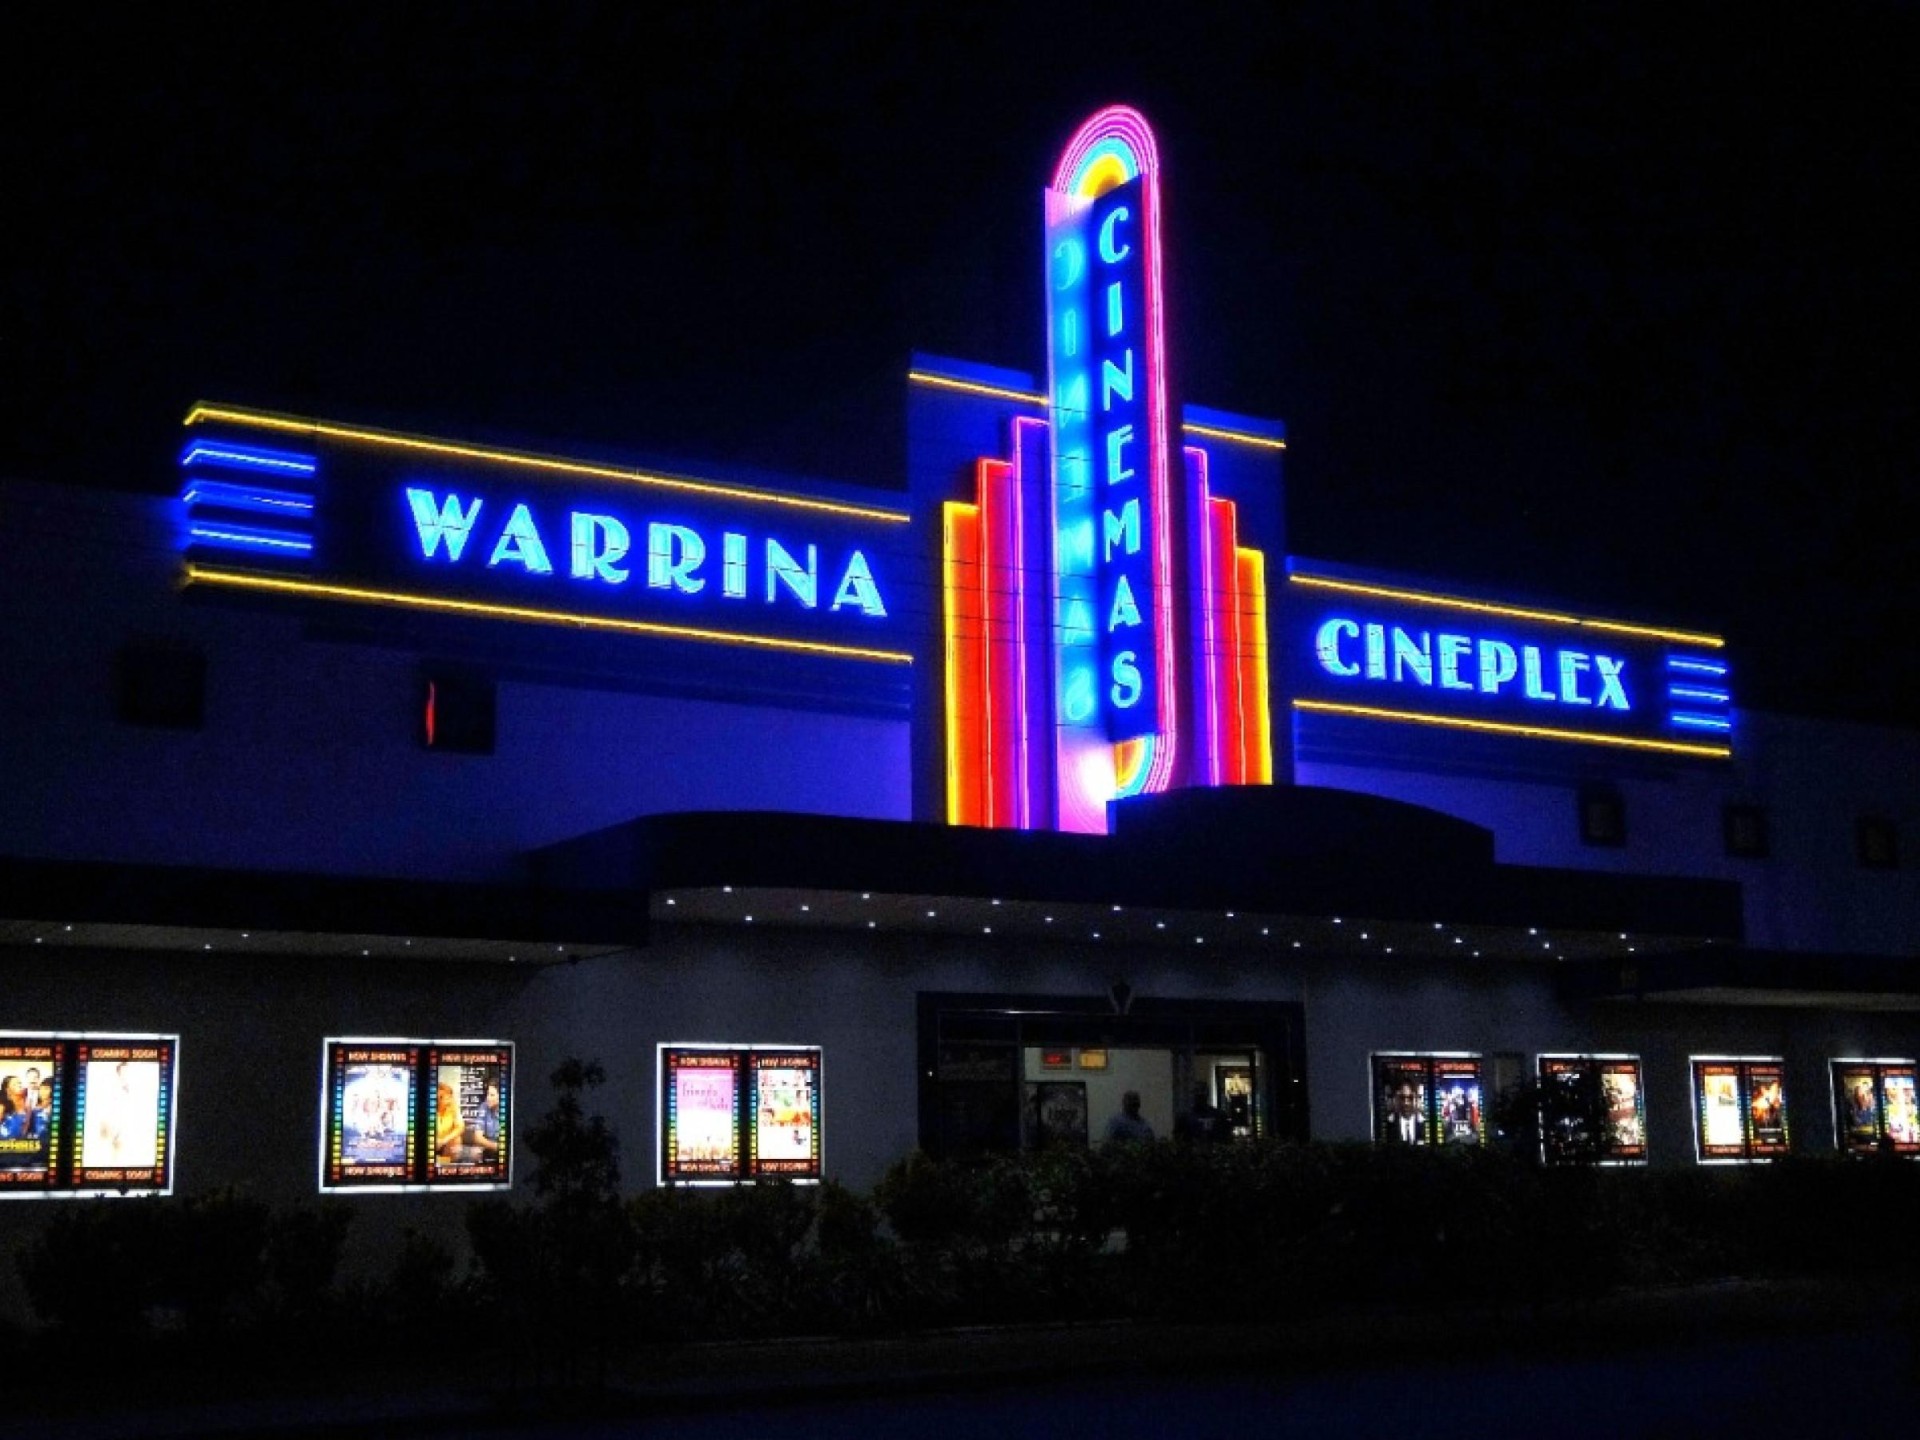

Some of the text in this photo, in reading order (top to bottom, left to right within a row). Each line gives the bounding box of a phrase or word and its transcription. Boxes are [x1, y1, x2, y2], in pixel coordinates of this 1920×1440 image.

[1099, 206, 1143, 709] CINEMAS
[406, 487, 887, 617] WARRINA
[1315, 618, 1630, 711] CINEPLEX
